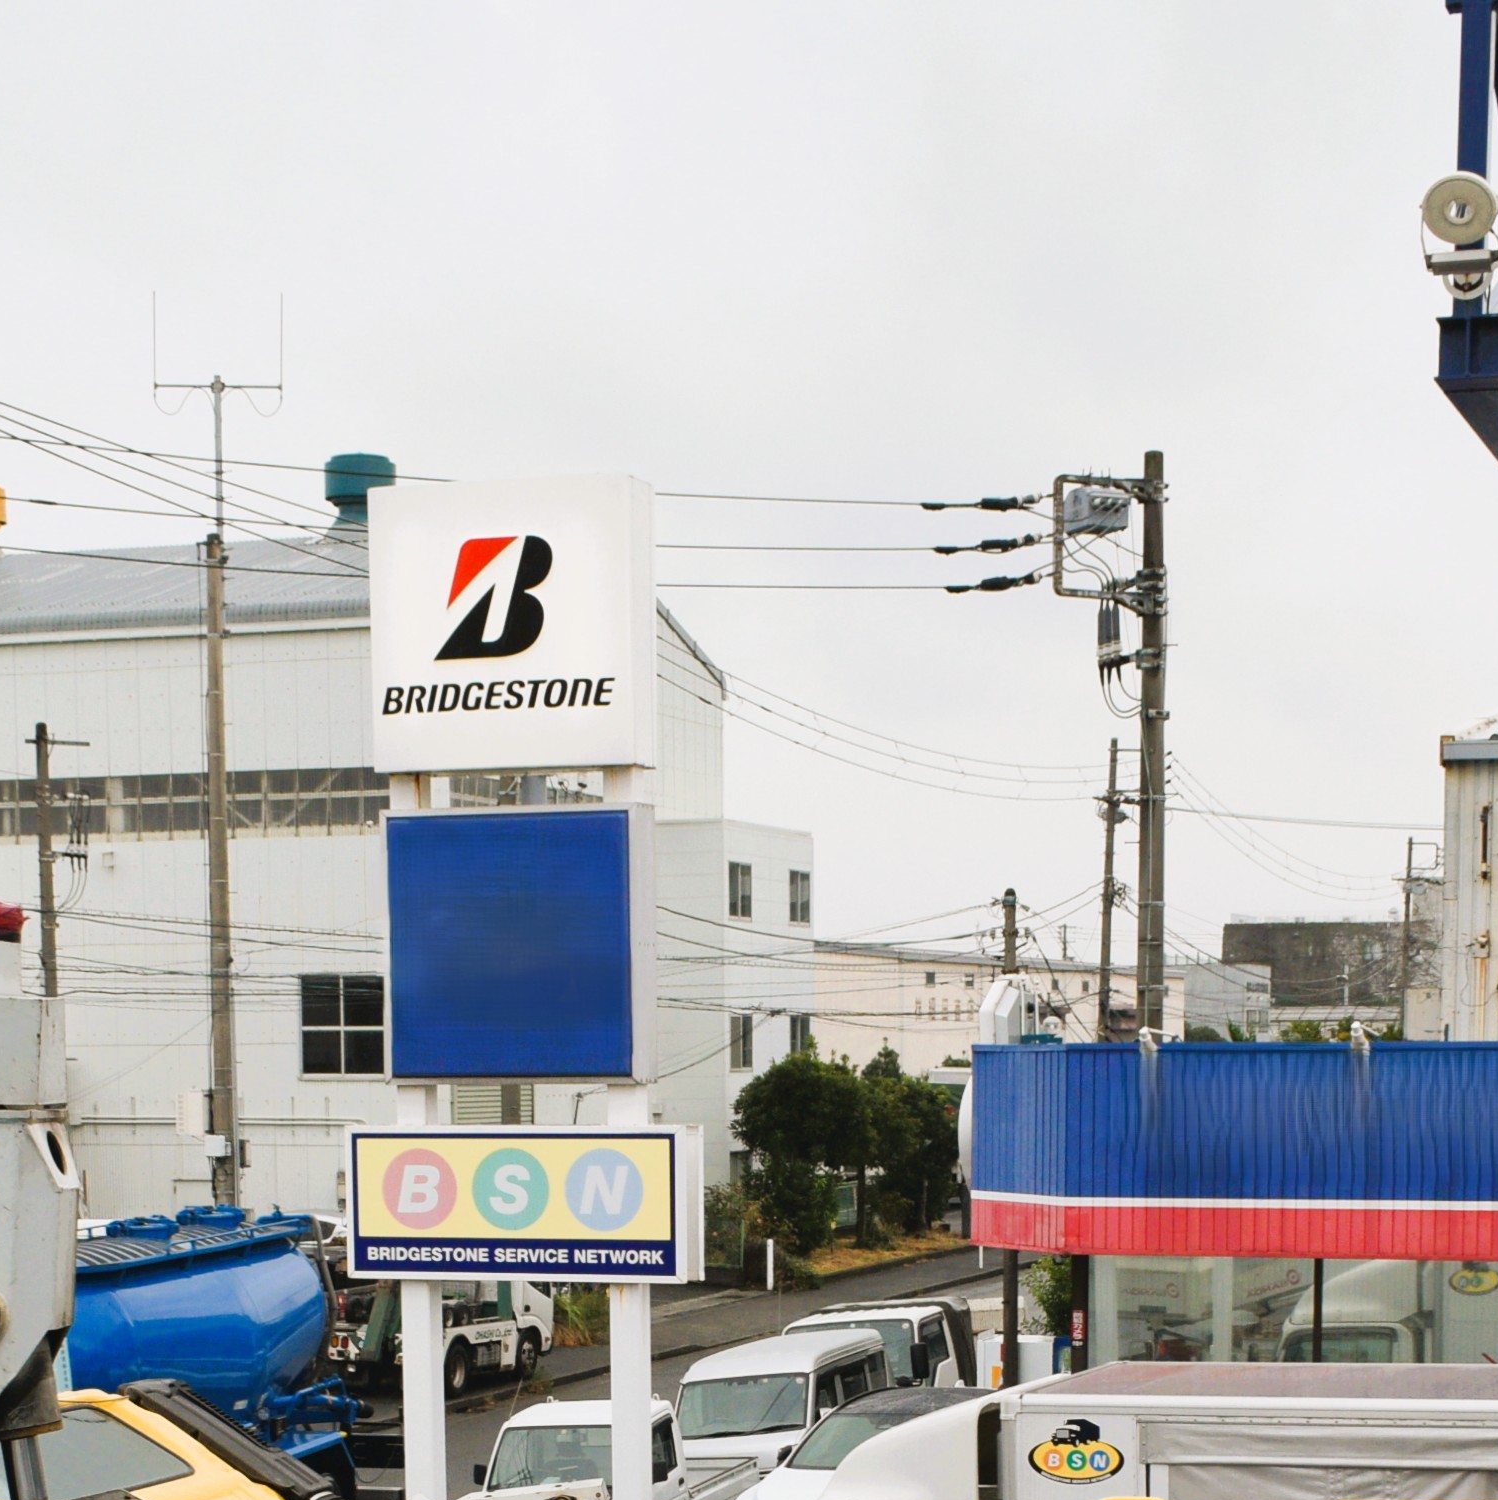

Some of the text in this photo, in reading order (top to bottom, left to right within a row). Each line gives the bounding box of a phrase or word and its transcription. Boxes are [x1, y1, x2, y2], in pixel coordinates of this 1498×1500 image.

[382, 677, 615, 715] BRIDGESTONE
[367, 1246, 664, 1266] BRIDGESTONE SERVICE NETWORK
